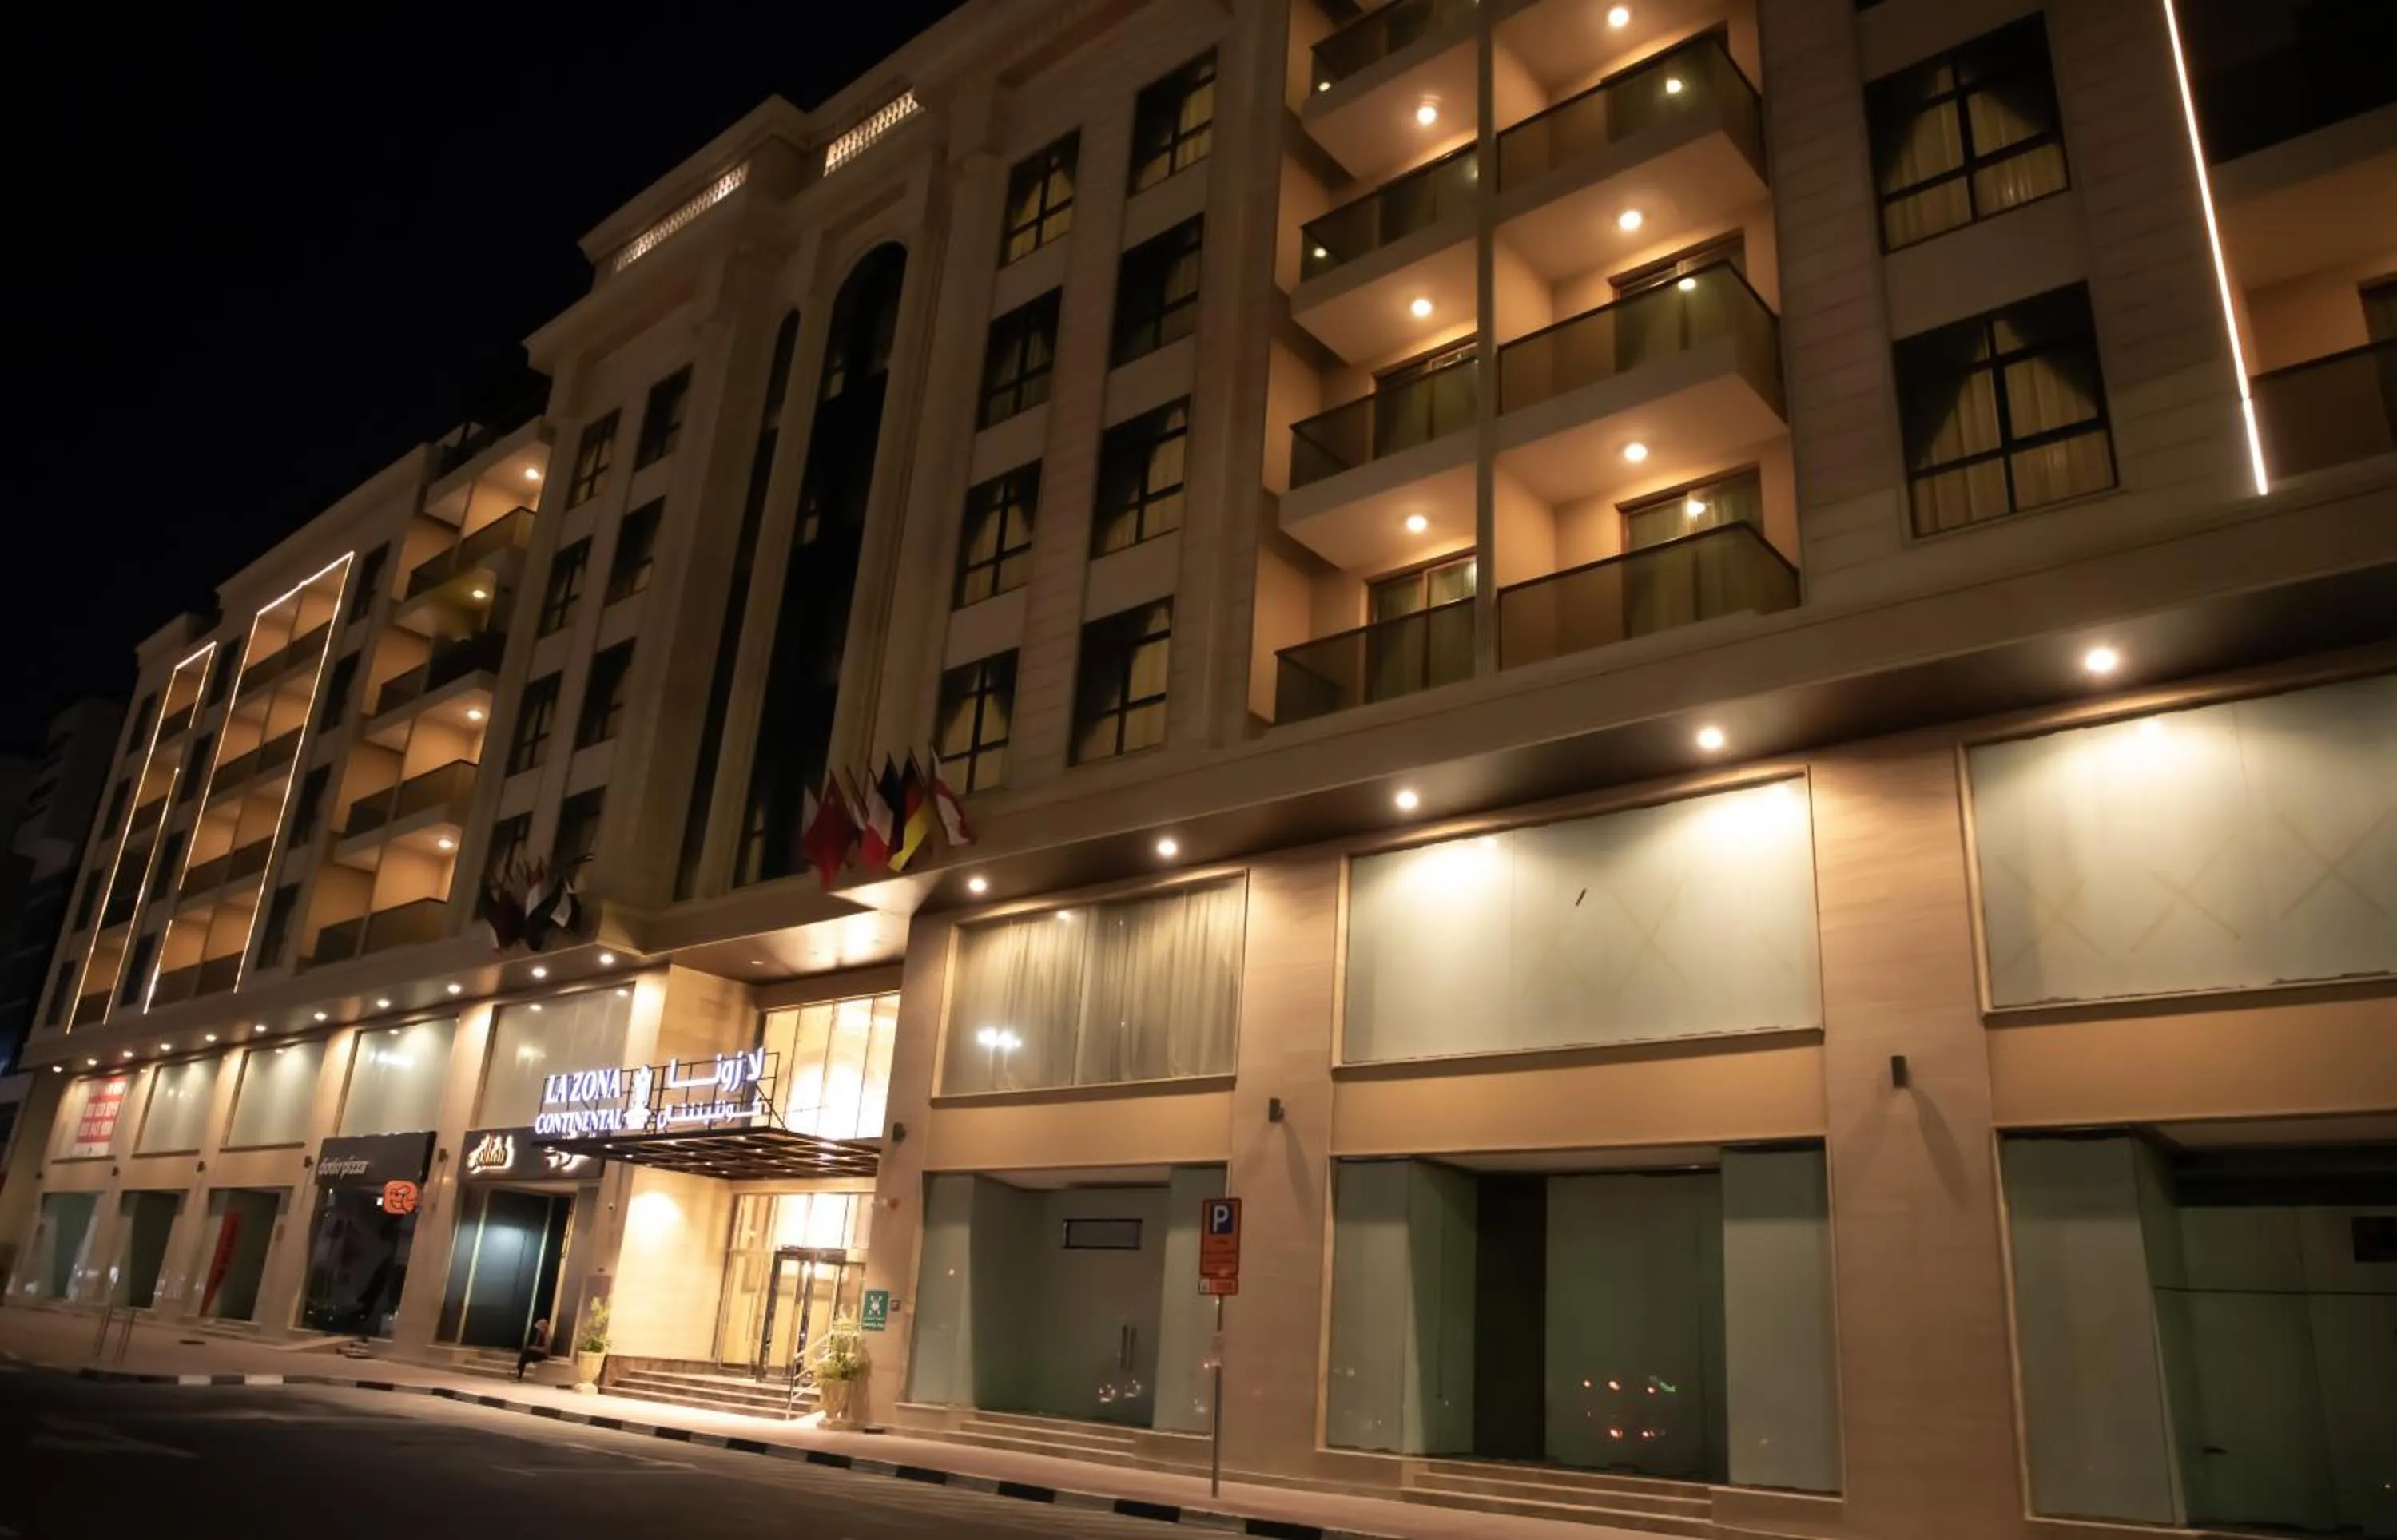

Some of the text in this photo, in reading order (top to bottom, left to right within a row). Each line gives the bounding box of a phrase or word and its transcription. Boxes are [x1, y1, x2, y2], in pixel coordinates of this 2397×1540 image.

[746, 1048, 765, 1081] لا
[569, 1067, 621, 1101] ZONA
[535, 1108, 622, 1135] CONTINENTAL
[1213, 1205, 1229, 1232] P
